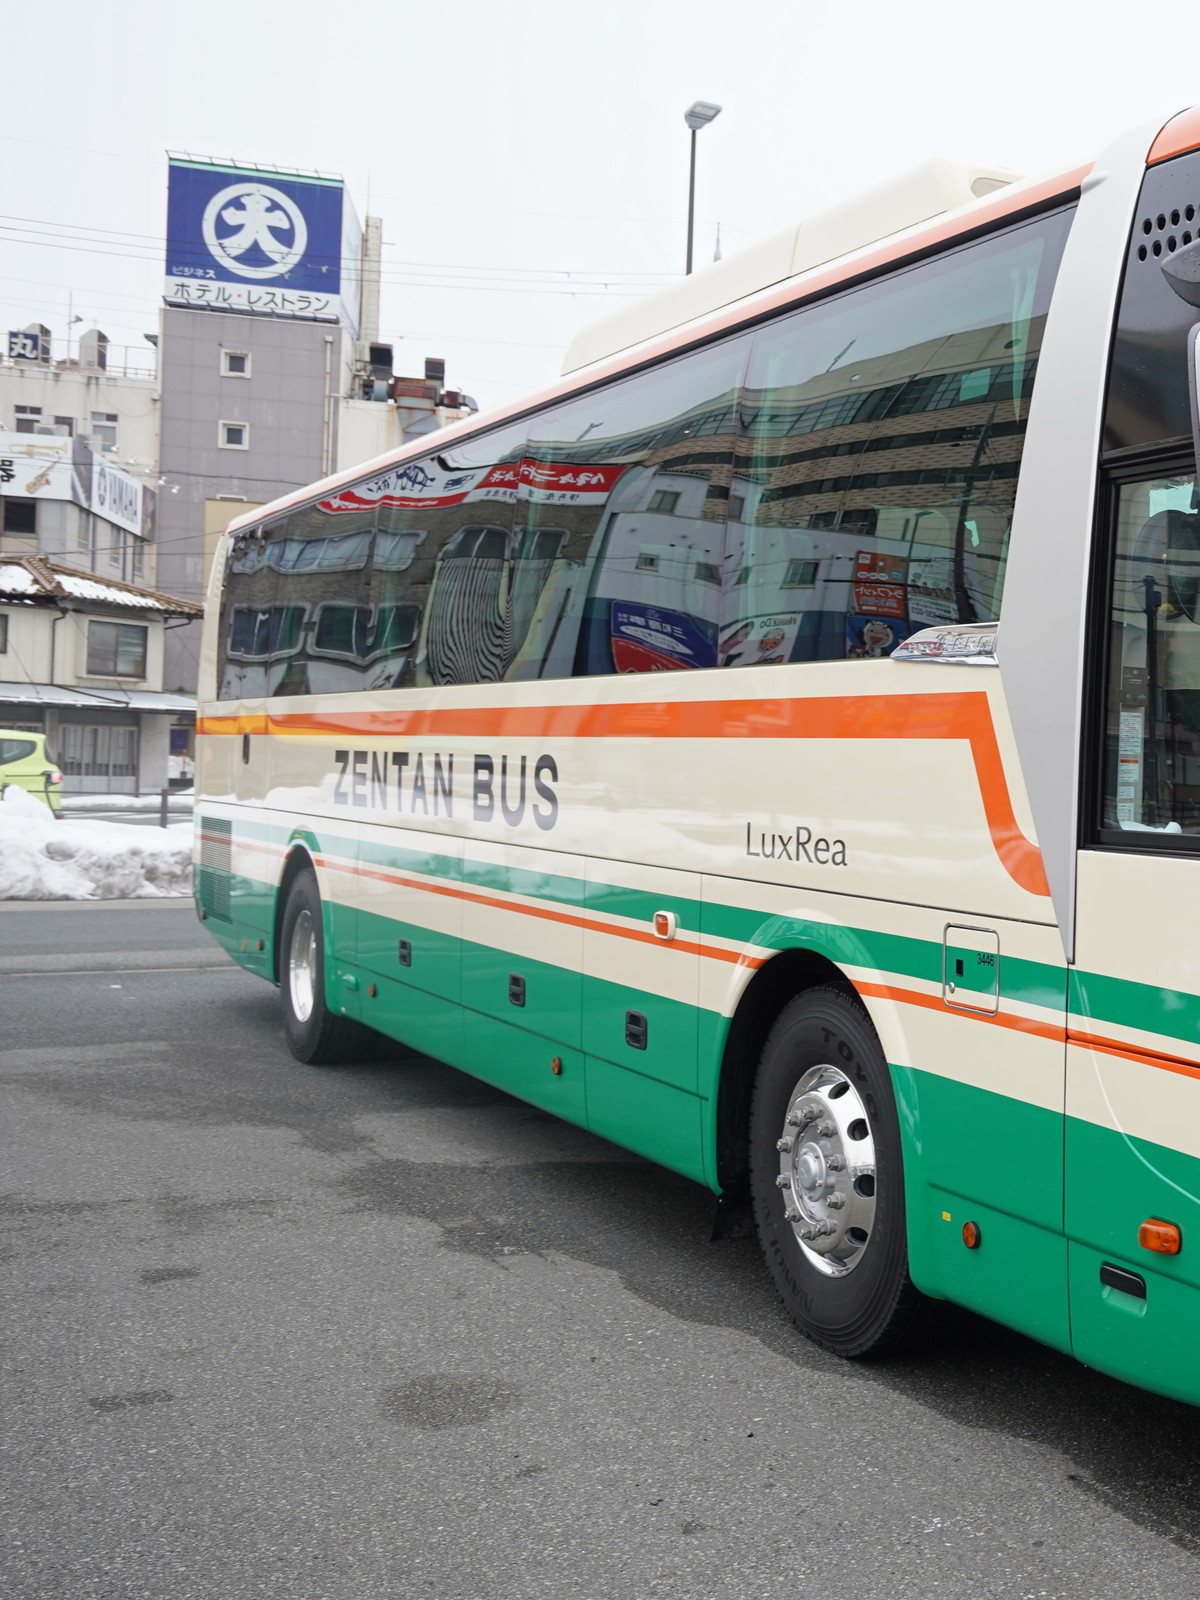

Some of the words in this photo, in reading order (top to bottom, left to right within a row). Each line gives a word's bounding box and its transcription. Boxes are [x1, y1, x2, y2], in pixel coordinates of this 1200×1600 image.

[172, 265, 217, 280] ビジネス
[173, 282, 330, 312] ホテル・レストラン
[9, 333, 38, 359] 丸
[334, 749, 456, 818] ZENTAN
[473, 754, 560, 831] BUS
[746, 822, 848, 867] LuxRea
[976, 952, 995, 967] 3446
[820, 1026, 877, 1118] TOYO
